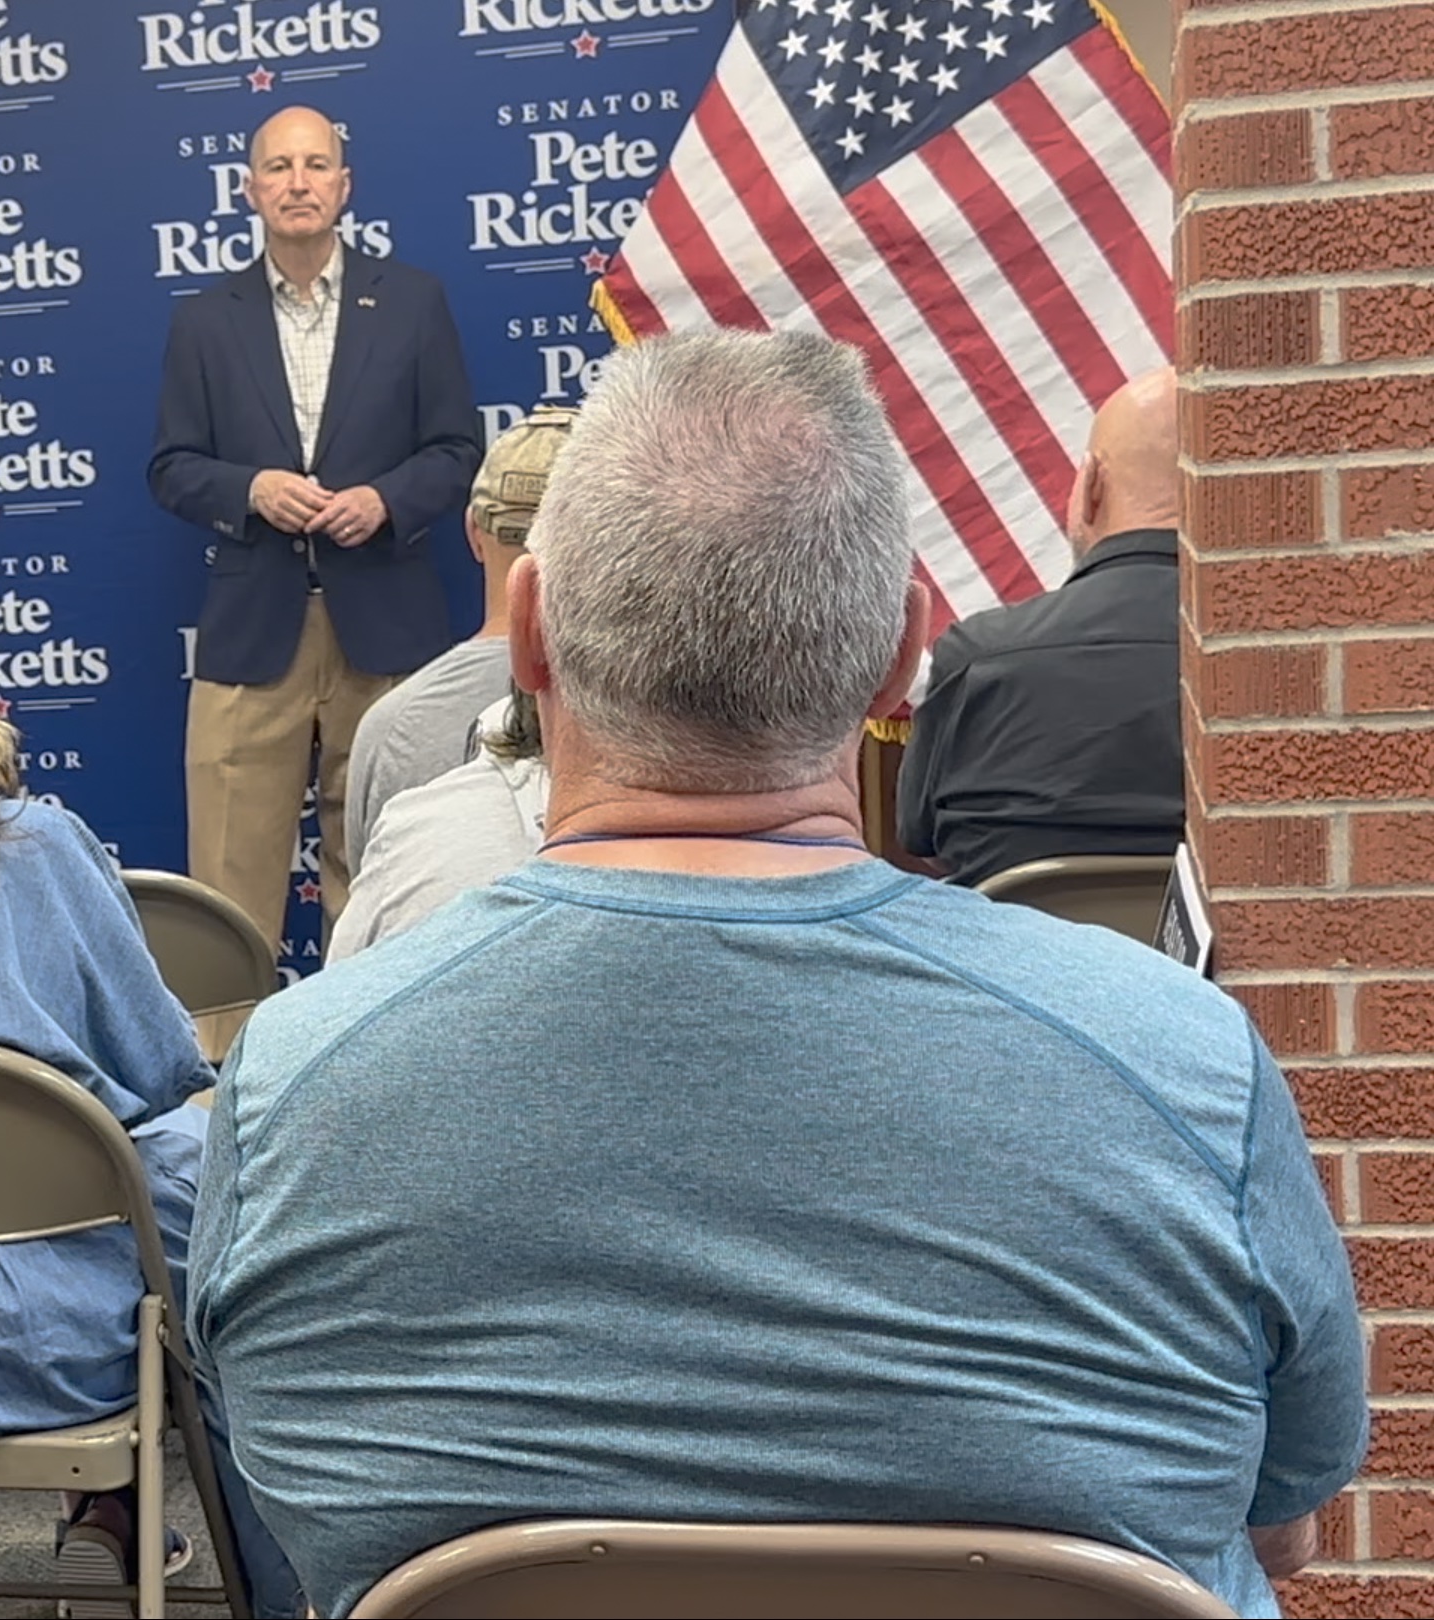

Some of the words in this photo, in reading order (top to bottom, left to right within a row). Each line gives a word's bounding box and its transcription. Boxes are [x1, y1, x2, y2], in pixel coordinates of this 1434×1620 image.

[137, 0, 381, 71] Ricketts
[497, 89, 679, 126] SENATOR
[178, 123, 351, 157] SENR
[528, 131, 657, 187] Pete
[151, 211, 393, 278] Ricts
[466, 183, 643, 251] Ricke
[507, 314, 606, 339] SENA
[538, 344, 602, 400] Pe
